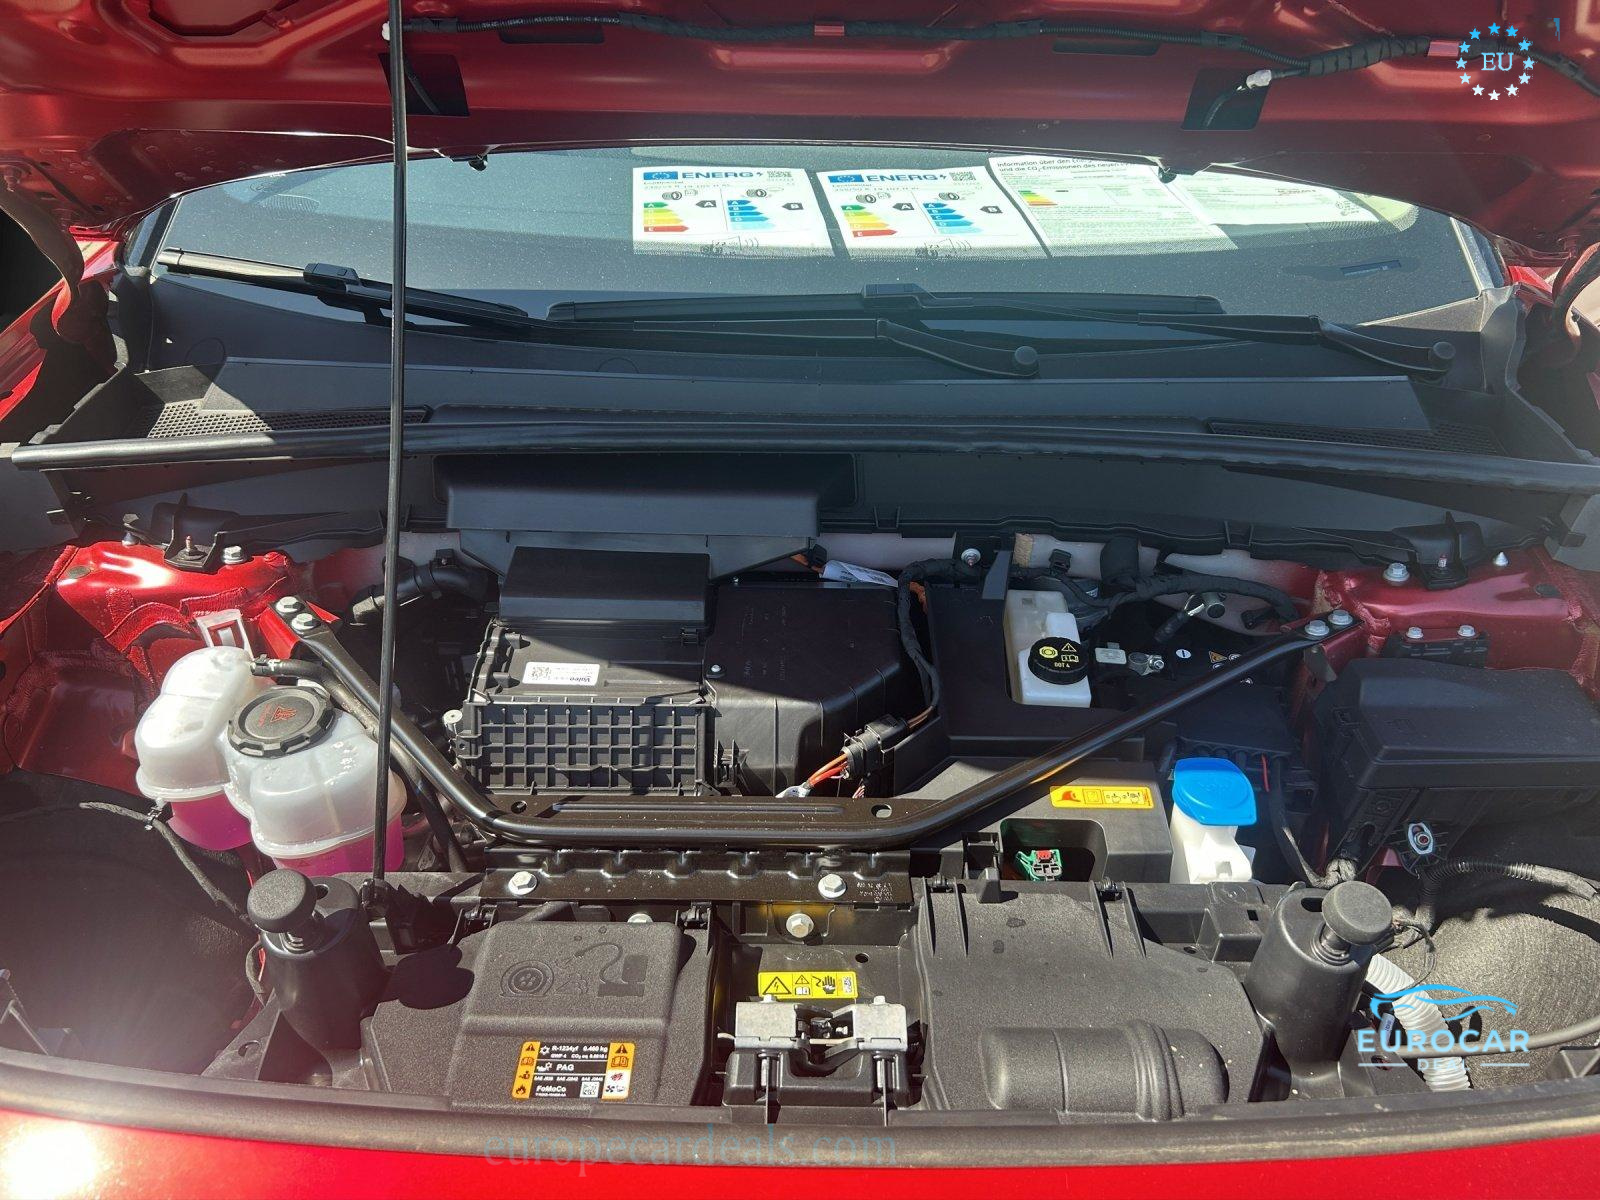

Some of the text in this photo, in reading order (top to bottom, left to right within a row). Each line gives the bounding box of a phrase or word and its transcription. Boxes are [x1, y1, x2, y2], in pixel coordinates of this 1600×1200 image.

[681, 171, 754, 179] ENERG
[866, 174, 939, 182] ENERG
[551, 1045, 579, 1053] R-1234yf
